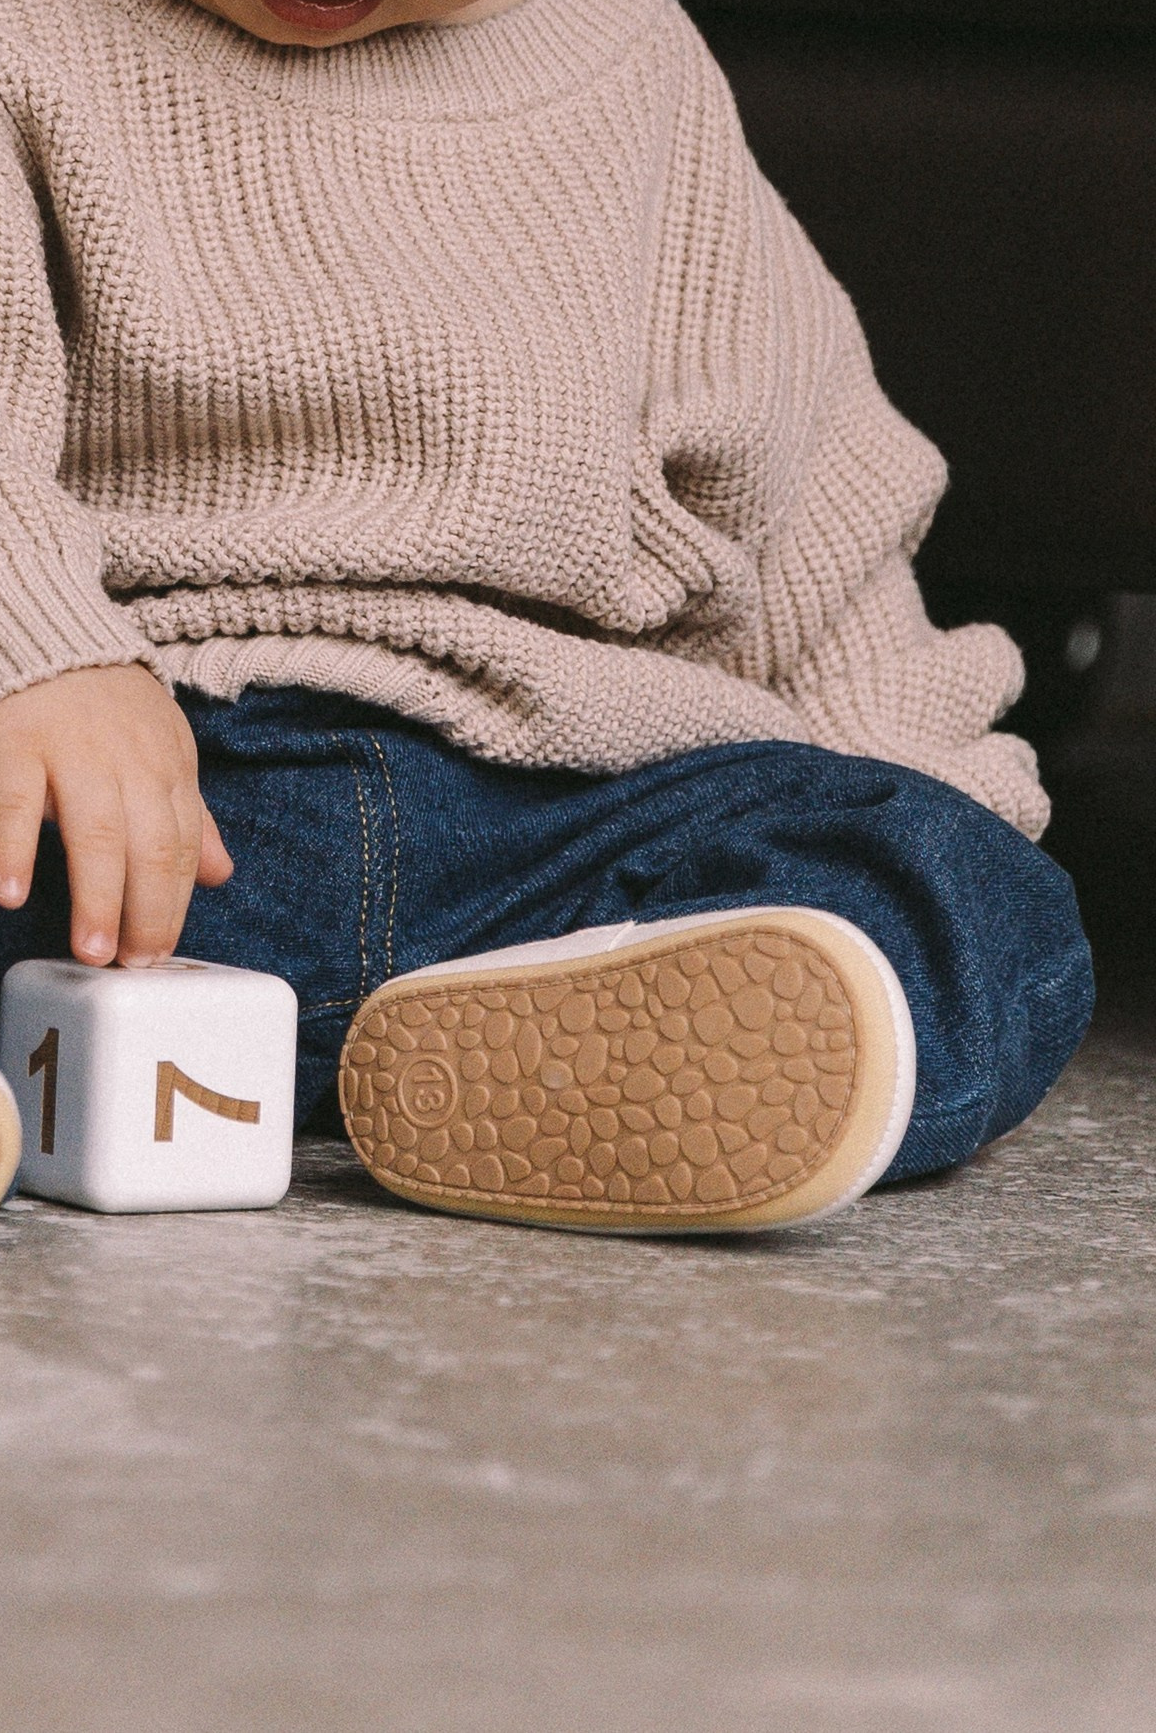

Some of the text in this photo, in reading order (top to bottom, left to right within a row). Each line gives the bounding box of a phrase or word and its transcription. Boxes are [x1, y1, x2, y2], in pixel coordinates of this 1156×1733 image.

[28, 1027, 60, 1155] 1
[154, 1060, 262, 1143] 7
[413, 1066, 445, 1114] 13
